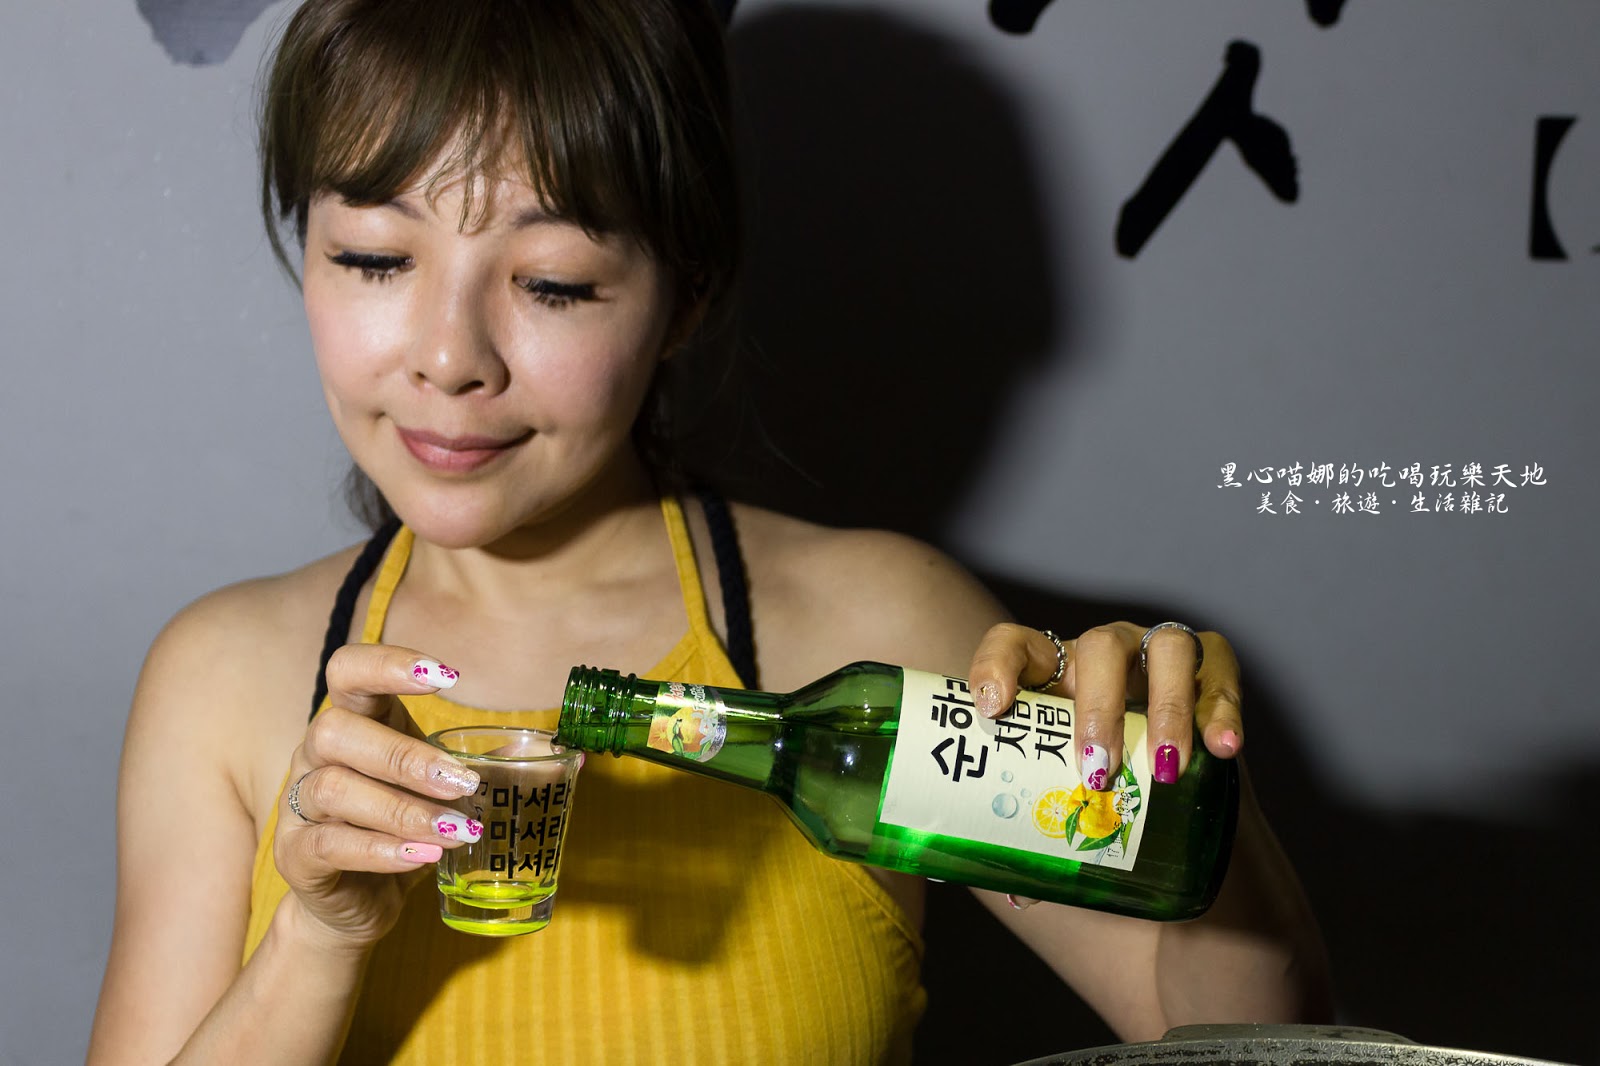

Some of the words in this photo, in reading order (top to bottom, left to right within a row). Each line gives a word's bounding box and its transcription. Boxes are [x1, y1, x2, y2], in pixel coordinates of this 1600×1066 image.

[1034, 703, 1072, 767] 처럼
[492, 779, 572, 815] 마셔라
[490, 812, 566, 849] 마셔라
[489, 846, 560, 879] 마셔라
